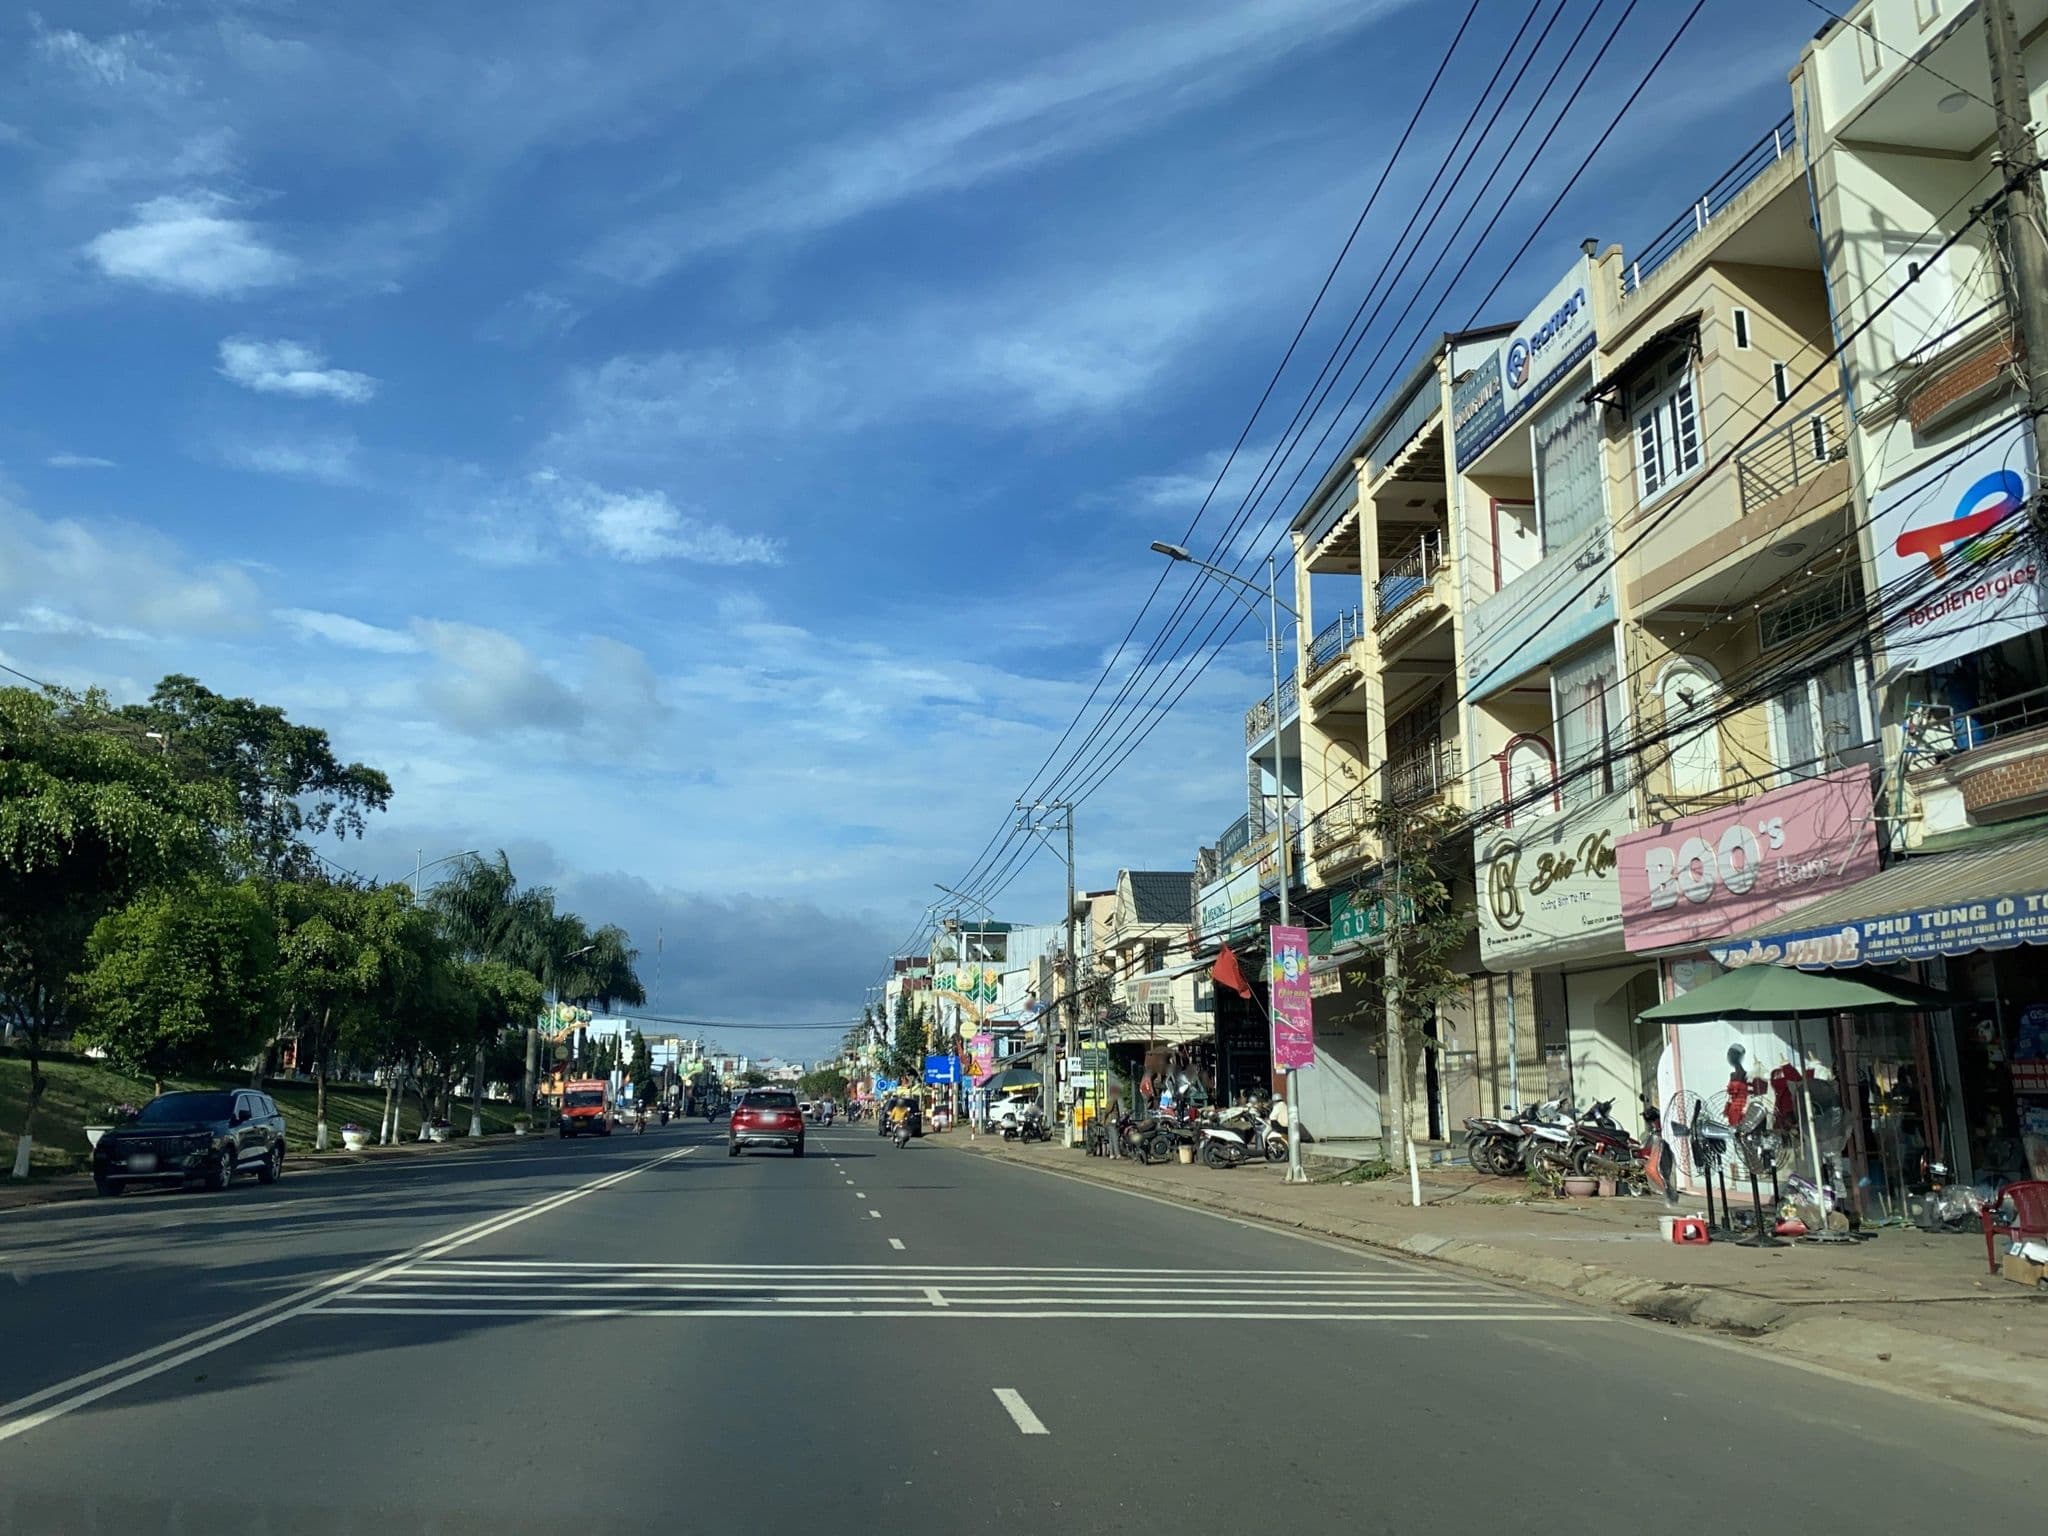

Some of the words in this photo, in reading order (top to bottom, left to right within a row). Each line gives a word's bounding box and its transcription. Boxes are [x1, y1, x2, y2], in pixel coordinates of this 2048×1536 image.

[1904, 564, 2037, 628] TotalEnergies
[1776, 856, 1831, 887] House
[1864, 916, 1911, 937] PHỤ
[1918, 904, 1987, 929] TÙNG
[1996, 897, 2015, 917] Ô
